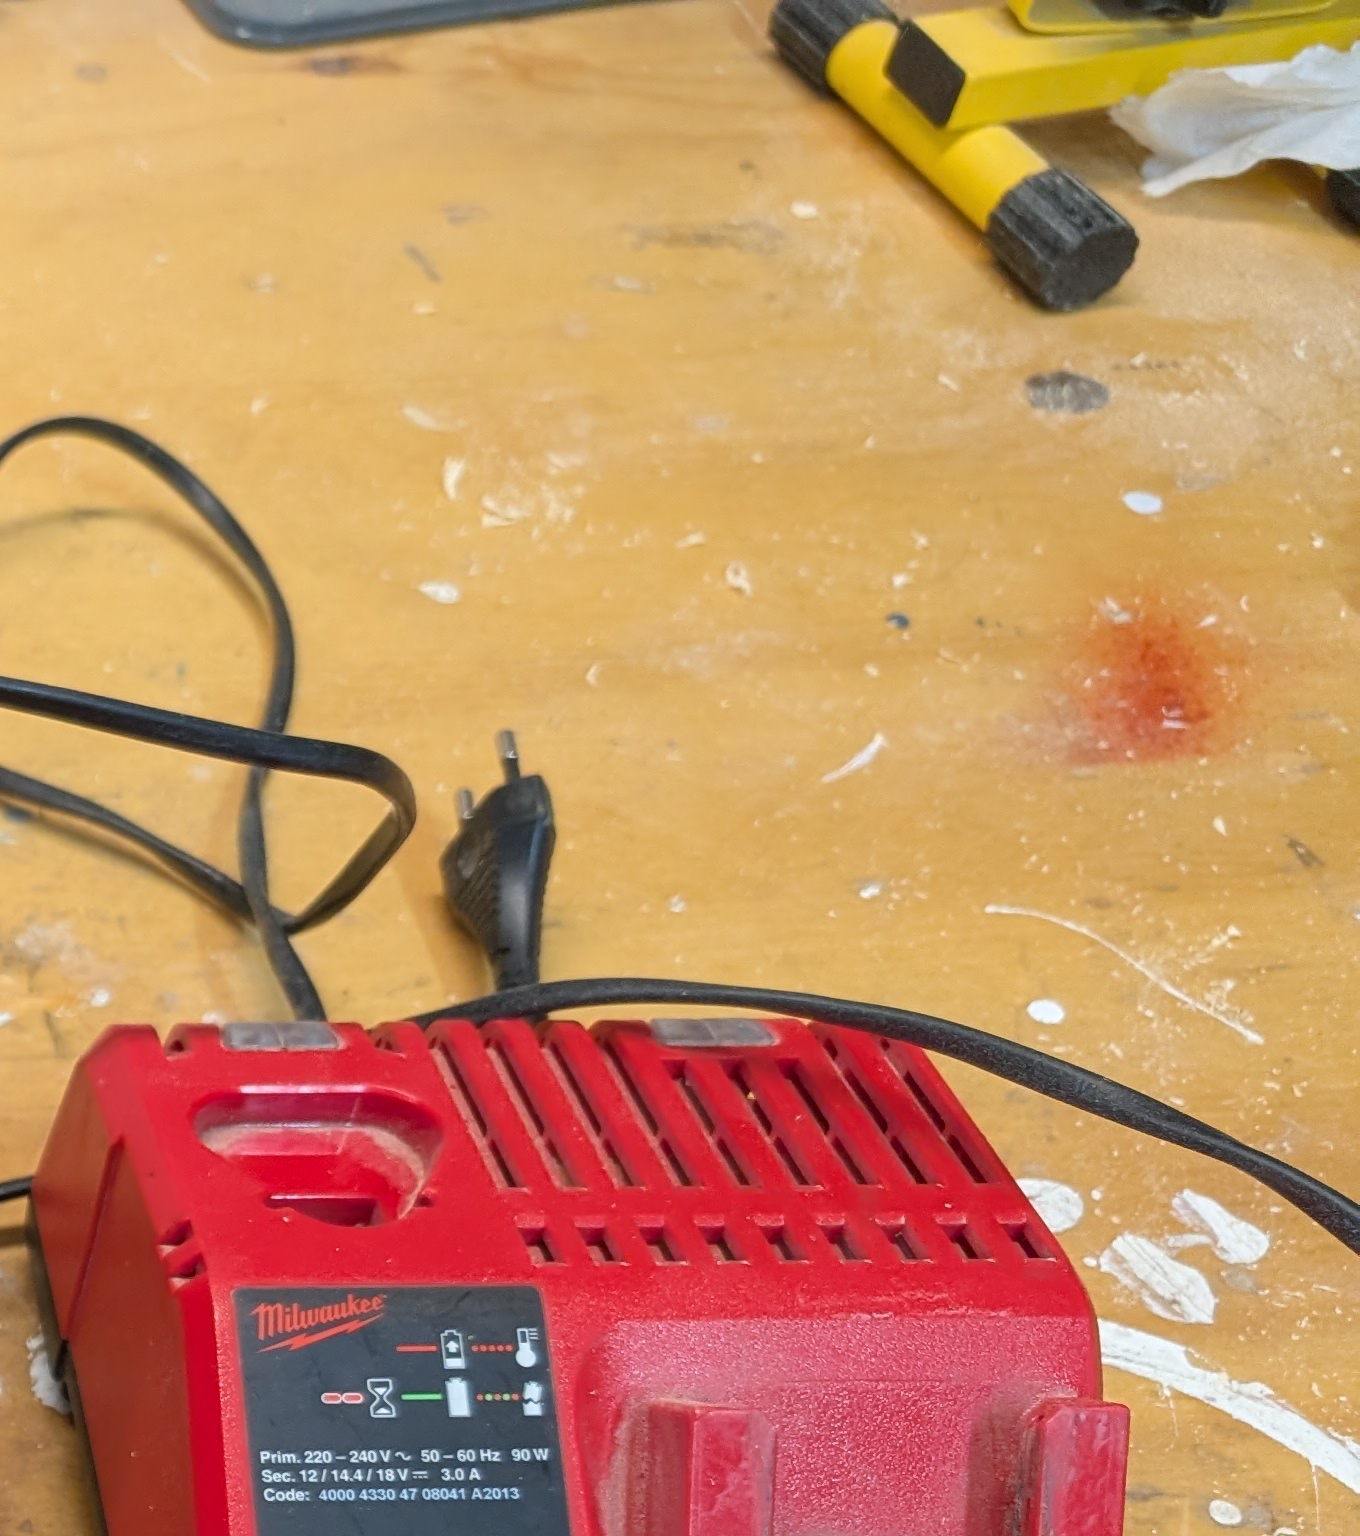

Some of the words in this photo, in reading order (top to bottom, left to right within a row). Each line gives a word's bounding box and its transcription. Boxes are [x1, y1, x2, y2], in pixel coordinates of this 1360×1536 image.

[250, 1293, 387, 1341] Milwaukee
[260, 1450, 301, 1464] Prim.
[304, 1450, 332, 1464] 220
[349, 1450, 377, 1463] 240
[379, 1449, 391, 1462] V
[420, 1449, 439, 1462] 50
[456, 1449, 476, 1462] 60
[479, 1448, 502, 1462] Hz
[511, 1448, 530, 1461] 90
[532, 1448, 549, 1461] W
[261, 1469, 296, 1483] Sec.
[299, 1469, 318, 1483] 12
[330, 1469, 363, 1482] 14.4
[376, 1468, 395, 1482] 18
[397, 1468, 408, 1481] V
[440, 1467, 464, 1481] 3.0
[468, 1467, 481, 1481] A
[263, 1488, 311, 1502] Code:
[319, 1489, 355, 1501] 4000
[359, 1488, 396, 1501] 4330
[399, 1488, 418, 1501] 47
[422, 1487, 466, 1500] 08041
